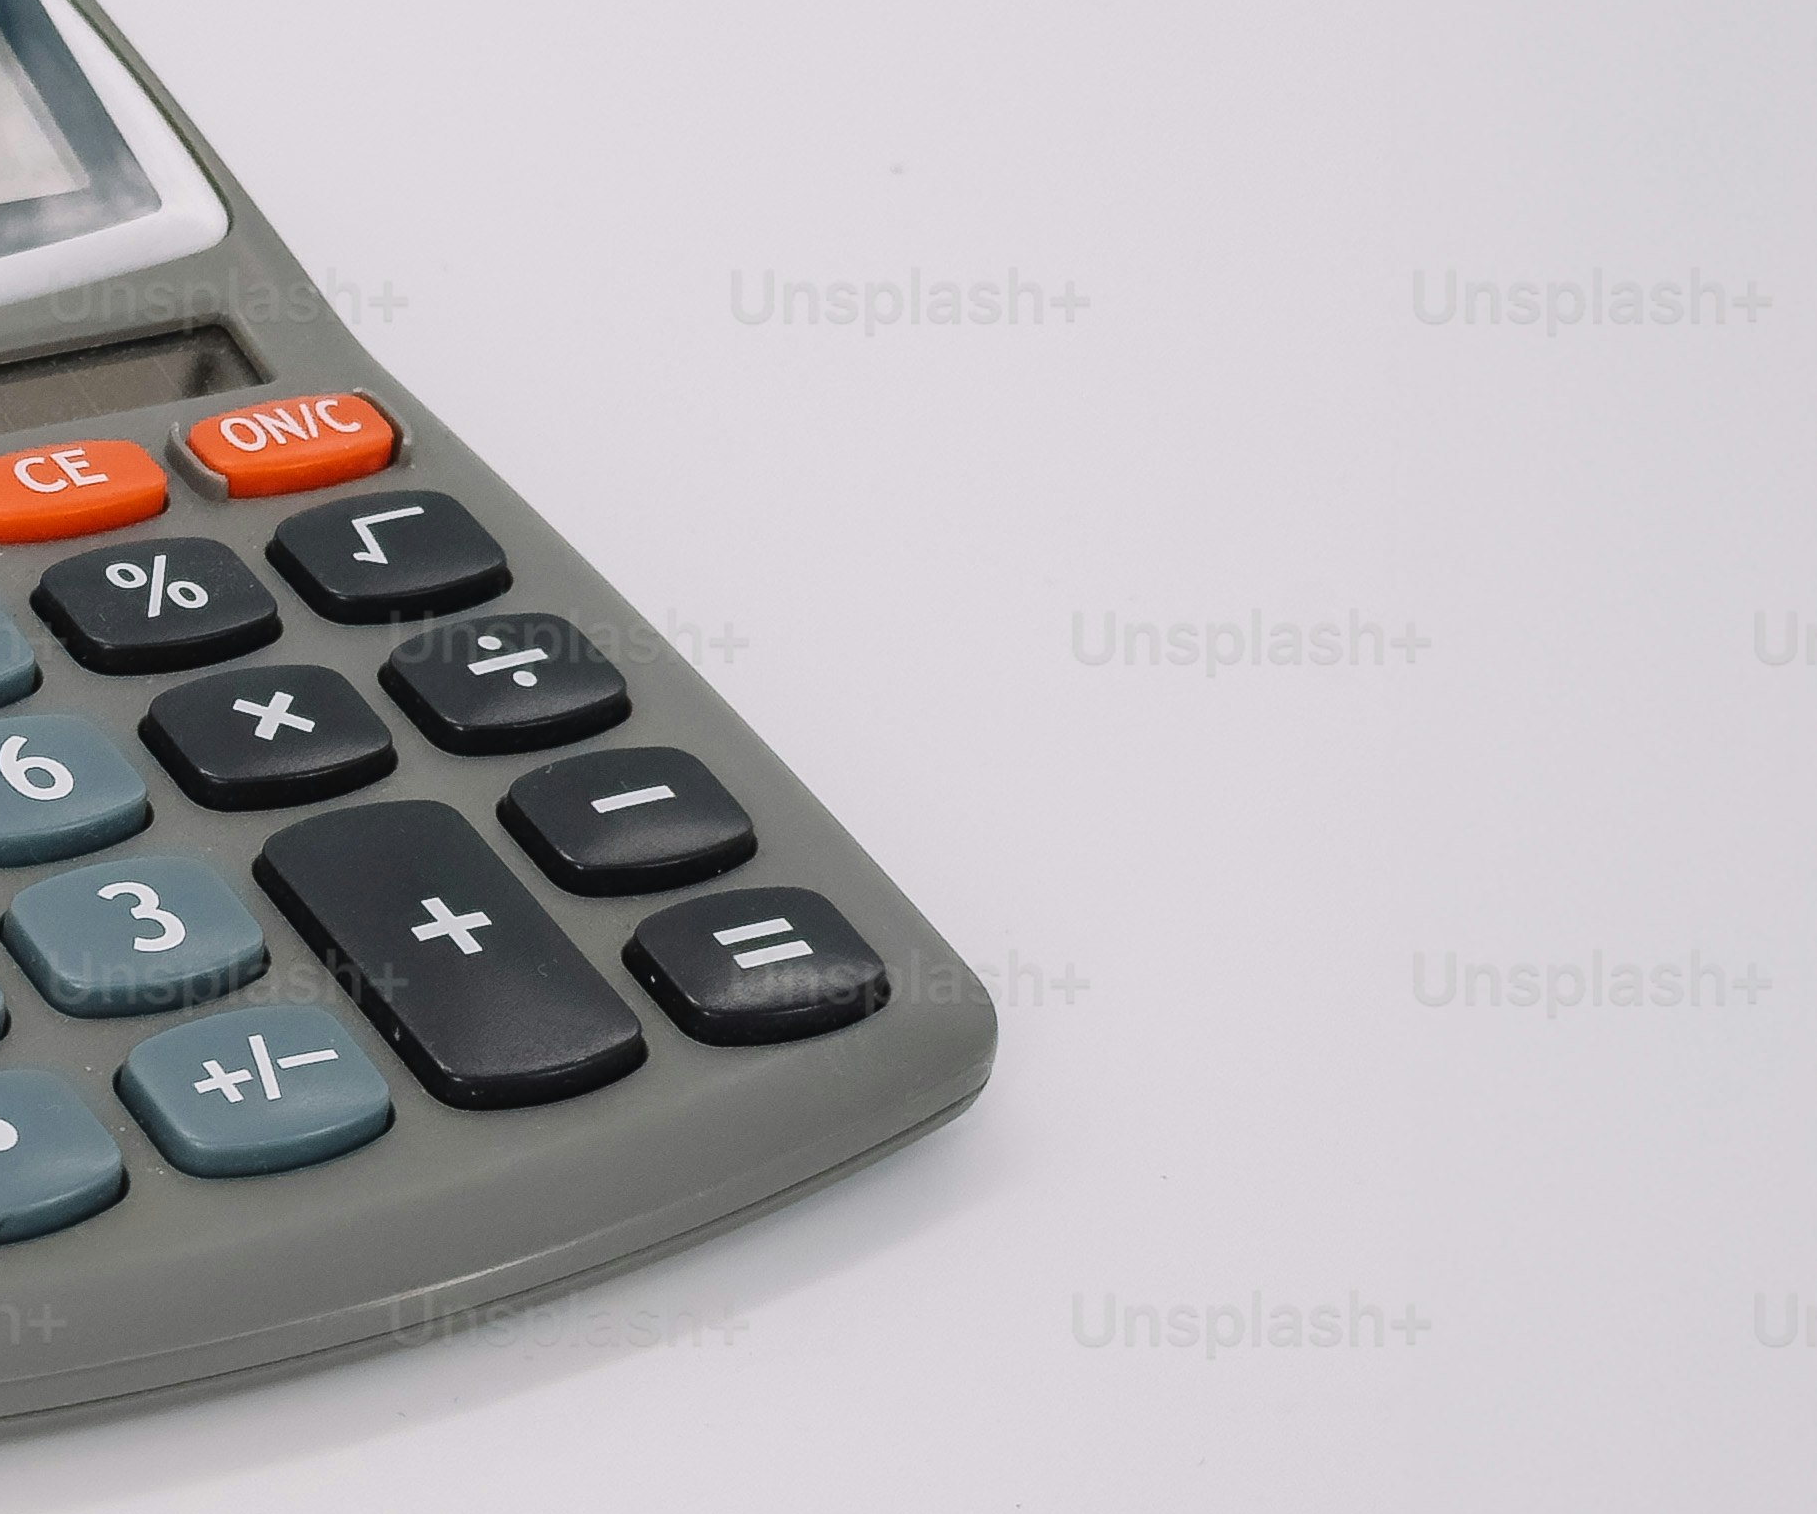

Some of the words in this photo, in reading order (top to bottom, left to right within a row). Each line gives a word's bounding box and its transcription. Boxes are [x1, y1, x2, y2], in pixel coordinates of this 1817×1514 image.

[220, 398, 362, 452] ON/C
[13, 447, 109, 493] CE
[105, 554, 209, 618] %
[467, 635, 549, 687] ÷
[96, 881, 186, 952] 3
[410, 897, 493, 955] +
[712, 917, 814, 969] =
